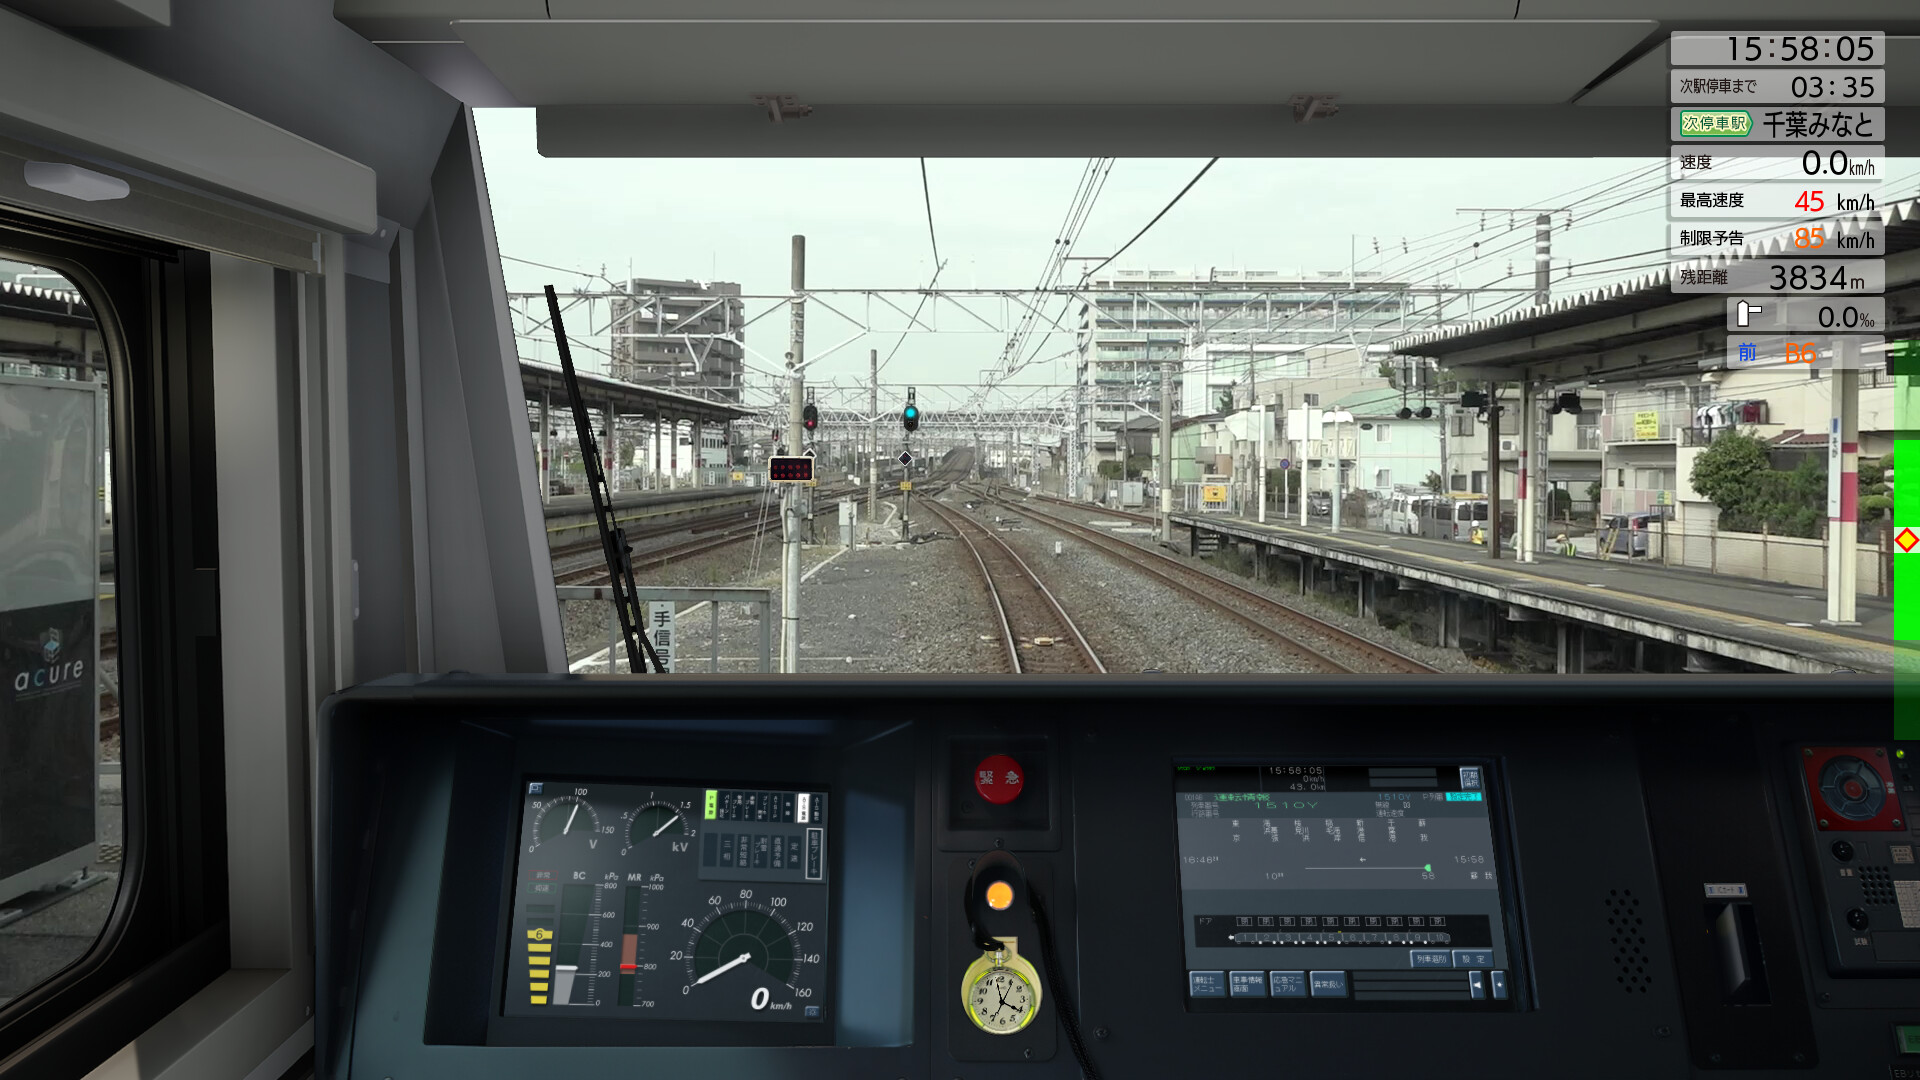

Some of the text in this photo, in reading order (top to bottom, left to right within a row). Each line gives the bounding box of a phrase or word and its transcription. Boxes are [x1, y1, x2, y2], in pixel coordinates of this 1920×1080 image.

[654, 610, 671, 674] 手信号
[15, 660, 84, 691] acure
[1270, 767, 1322, 775] 15:58:05
[532, 802, 542, 810] 50
[680, 802, 691, 810] 1.5
[601, 826, 614, 834] 150
[590, 840, 598, 850] V
[672, 842, 688, 852] kV
[740, 890, 752, 899] 80
[708, 896, 721, 905] 60
[770, 897, 787, 907] 100
[681, 918, 694, 928] 40
[797, 922, 814, 932] 120
[536, 929, 543, 940] 6
[670, 951, 683, 961] 20
[803, 954, 820, 964] 140
[683, 986, 689, 995] 0
[795, 988, 812, 998] 160
[751, 987, 792, 1011] 0 km/h
